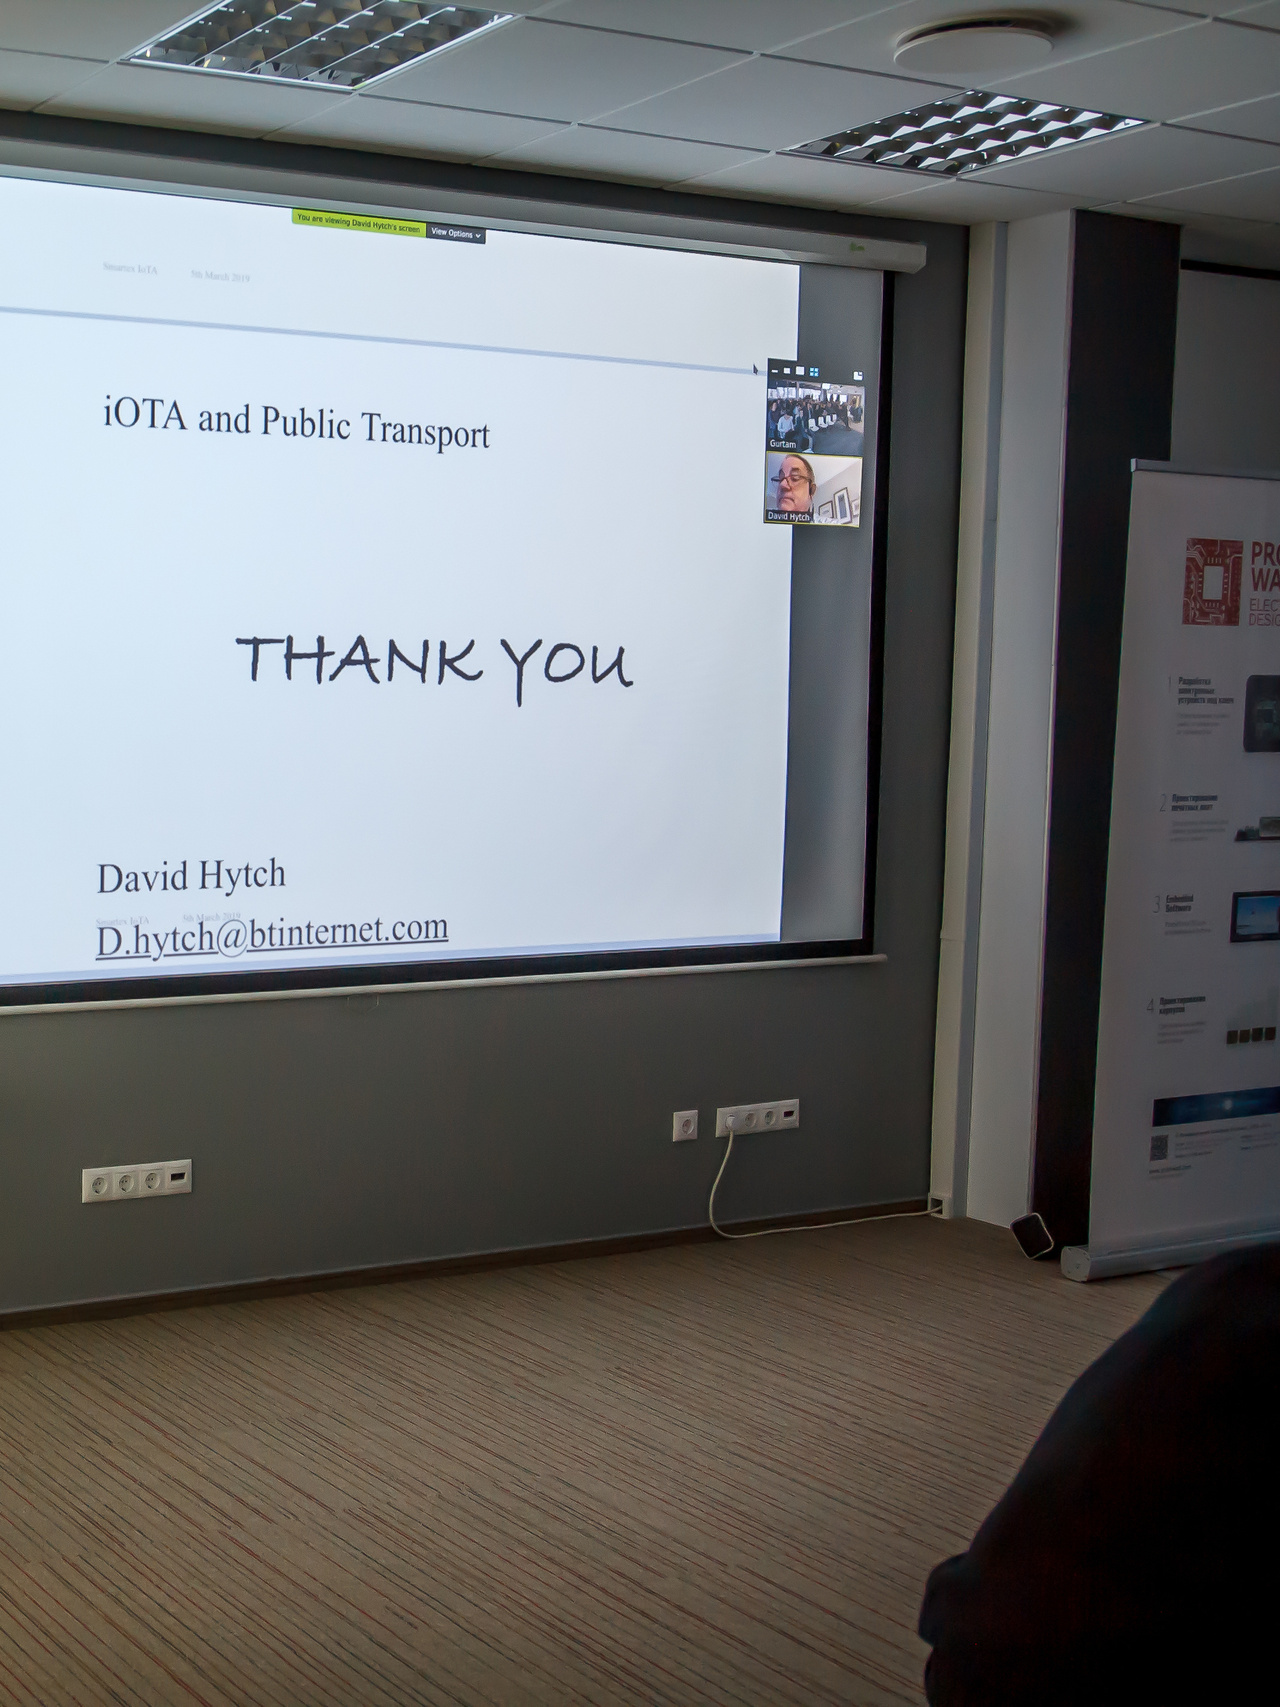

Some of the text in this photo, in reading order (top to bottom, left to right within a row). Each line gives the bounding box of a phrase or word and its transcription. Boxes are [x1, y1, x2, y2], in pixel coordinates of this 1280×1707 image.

[297, 213, 421, 233] You are viewing David Hytch's screen
[431, 227, 473, 239] View Options
[204, 270, 230, 282] March
[103, 394, 491, 454] iOTA and Public Transport
[769, 439, 797, 449] Gurtam
[767, 511, 810, 523] David Hytch
[235, 634, 634, 708] THANK YOU
[97, 857, 286, 897] David Hytch
[96, 917, 449, 962] D.hytch@btinternet.com
